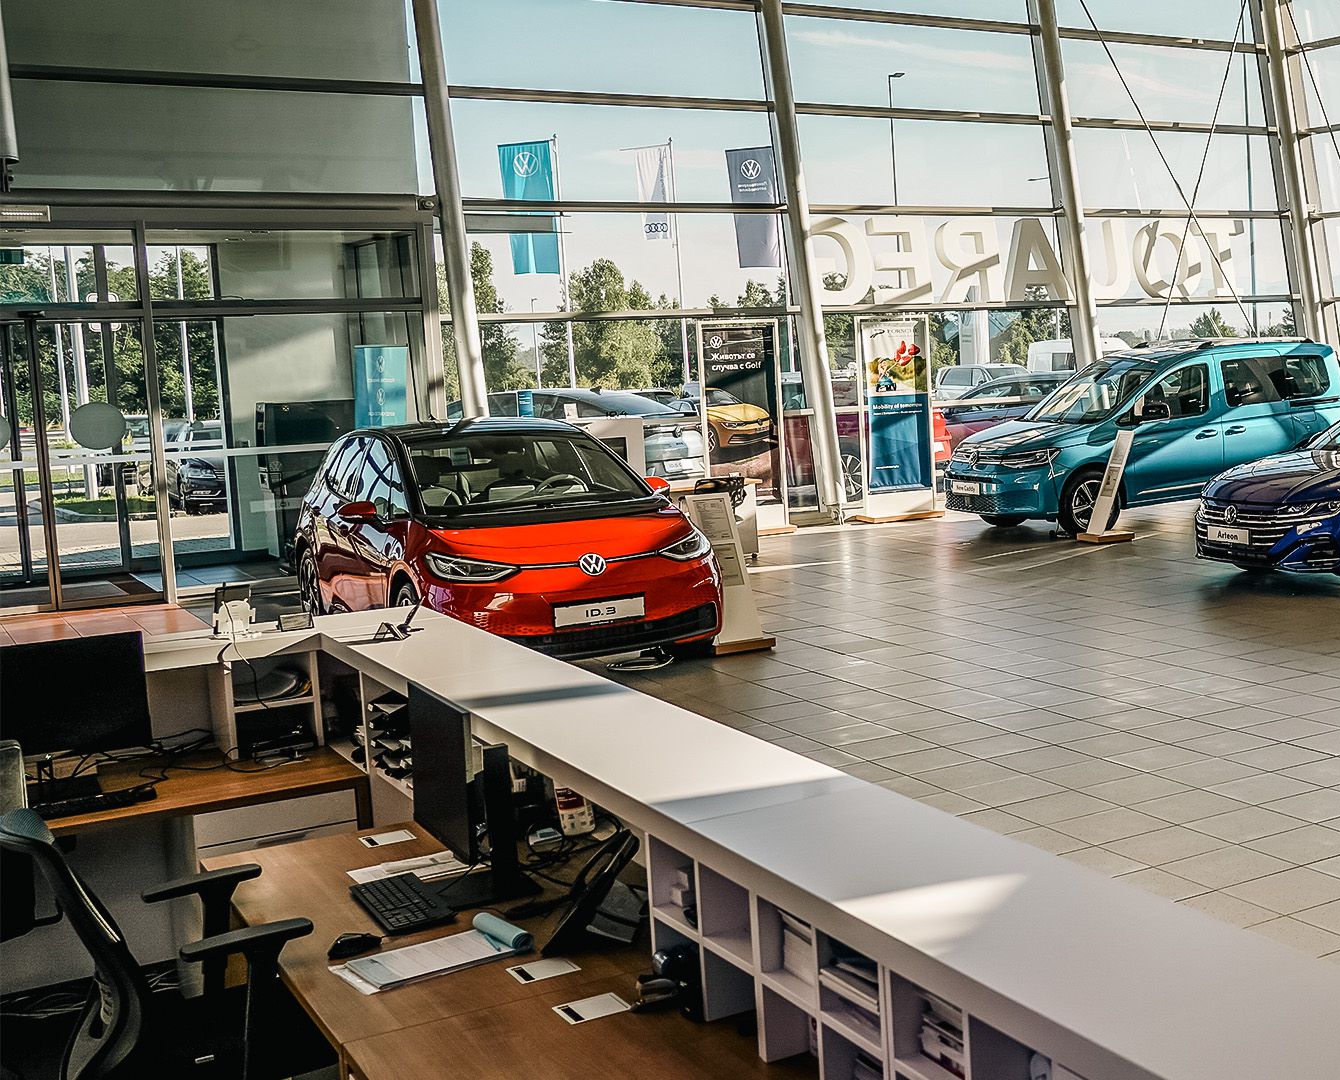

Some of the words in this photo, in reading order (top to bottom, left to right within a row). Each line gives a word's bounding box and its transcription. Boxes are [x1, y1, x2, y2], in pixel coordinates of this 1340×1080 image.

[711, 353, 745, 361] Животът
[711, 363, 738, 372] случва
[745, 361, 762, 369] Golf
[1217, 530, 1239, 541] Arteon
[585, 606, 617, 618] ID.3
